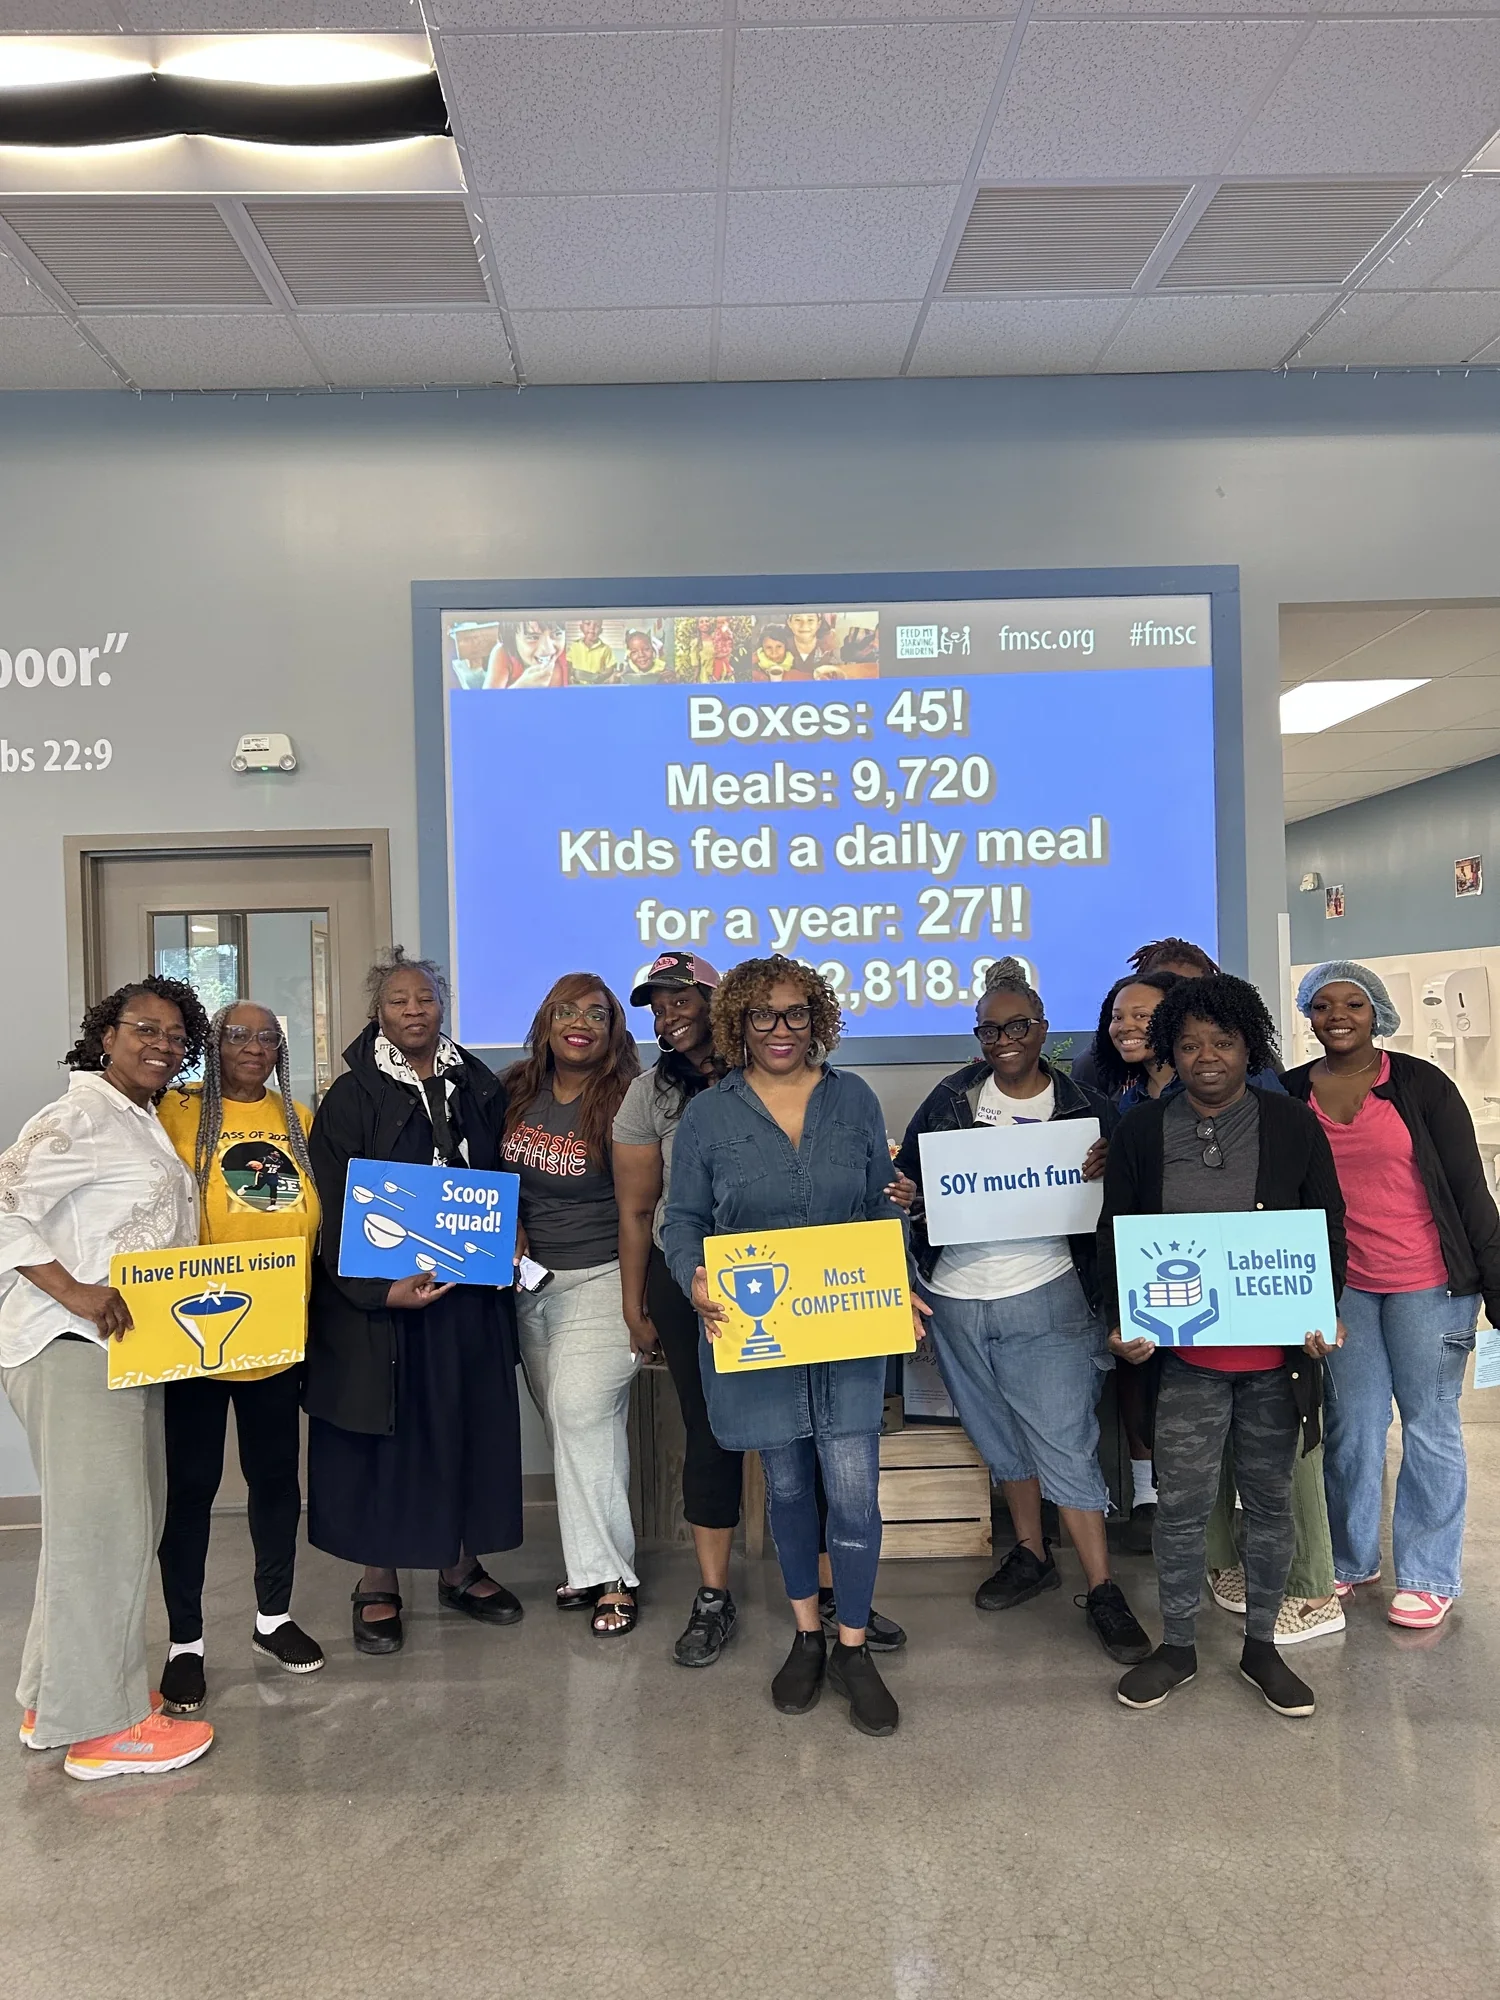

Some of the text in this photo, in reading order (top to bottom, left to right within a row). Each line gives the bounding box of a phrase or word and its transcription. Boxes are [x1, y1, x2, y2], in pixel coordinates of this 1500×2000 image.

[900, 628, 933, 638] FEED MY
[900, 638, 934, 647] STARVING
[998, 625, 1095, 655] fmsc.org
[1129, 620, 1197, 647] #fmsc
[900, 647, 934, 656] CHILDREN
[690, 689, 964, 740] Boxes: 45!
[43, 738, 113, 772] 22:9
[667, 756, 990, 809] Meals: 9,720
[561, 817, 1103, 876] Kids fed a daily meal
[636, 886, 1024, 951] for a year: 27!!
[979, 1106, 1001, 1115] ROUD
[248, 1130, 265, 1139] OF
[940, 1164, 1088, 1196] SOY much fun
[441, 1180, 500, 1210] Scoop
[435, 1211, 502, 1235] squad!
[121, 1251, 296, 1286] I have FUNNEL vision
[1227, 1248, 1317, 1274] Labeling
[823, 1267, 866, 1287] Most
[1235, 1275, 1314, 1297] LEGEND
[791, 1287, 904, 1317] COMPETITIVE
